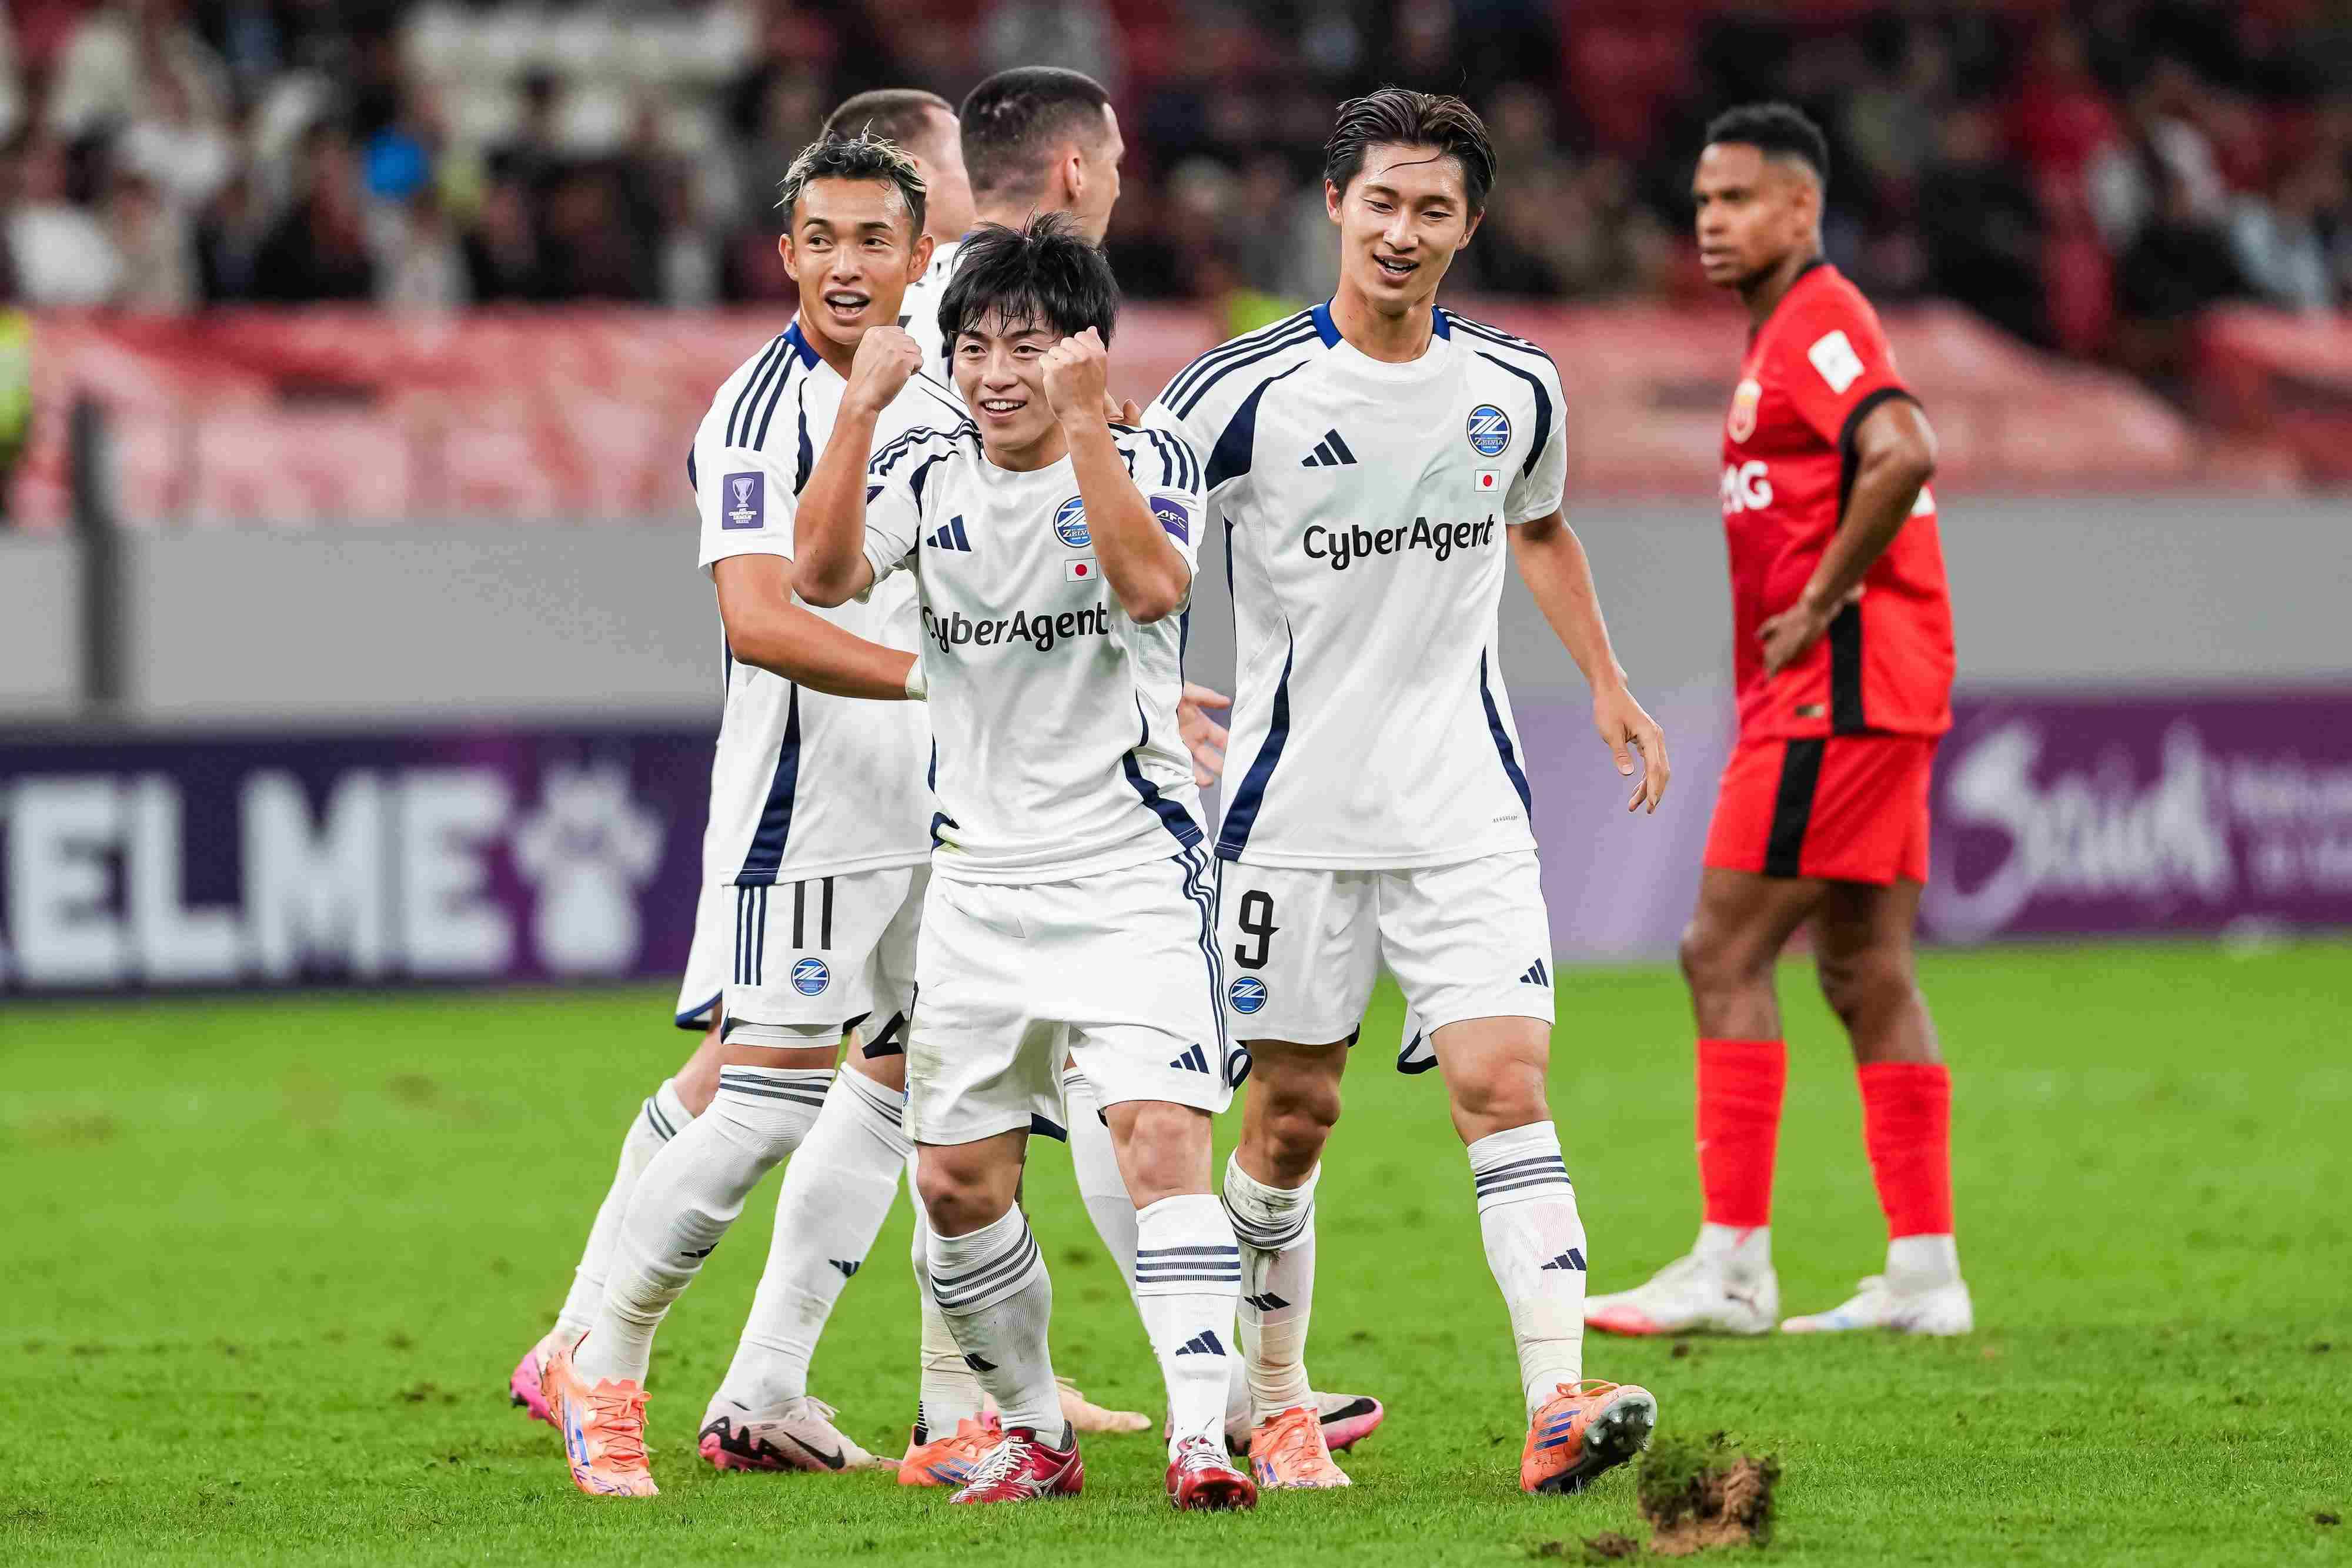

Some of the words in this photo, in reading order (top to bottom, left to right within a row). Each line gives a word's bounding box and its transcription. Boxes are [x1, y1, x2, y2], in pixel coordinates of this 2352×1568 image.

[1157, 509, 1187, 529] AFC
[1303, 513, 1494, 570] CyberAgent
[922, 601, 1108, 654] CyberAgent
[0, 775, 513, 983] ELME
[792, 877, 834, 950] 11
[1234, 889, 1282, 970] 9
